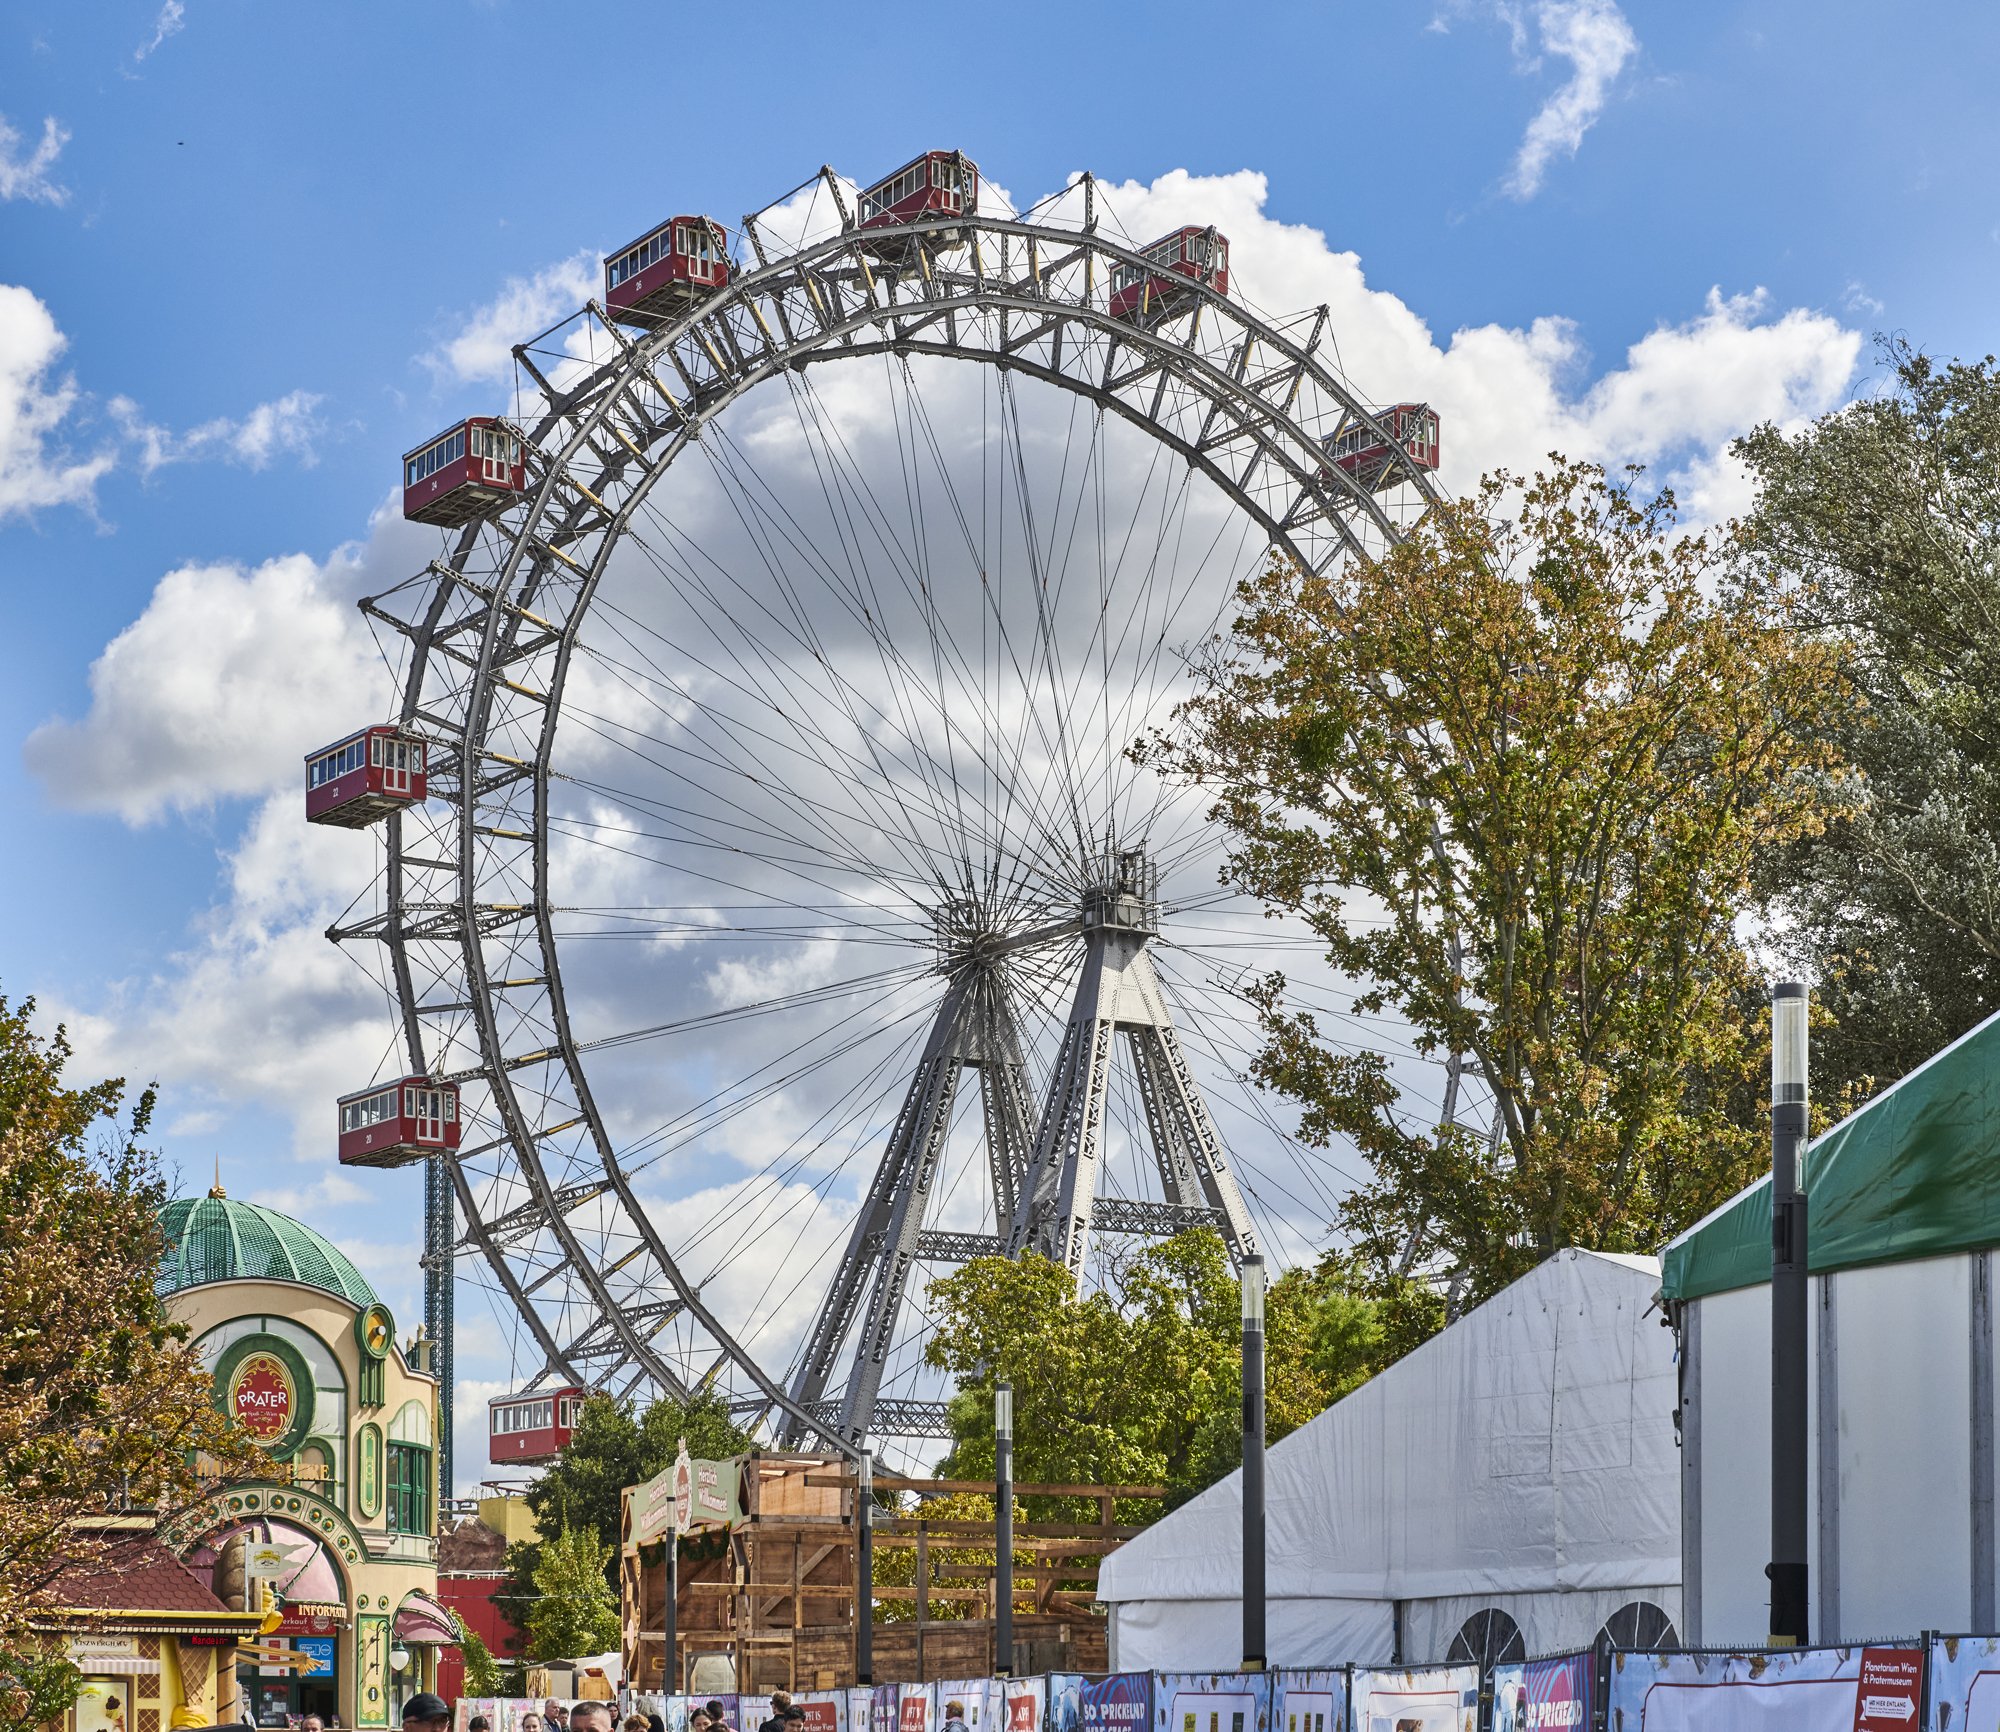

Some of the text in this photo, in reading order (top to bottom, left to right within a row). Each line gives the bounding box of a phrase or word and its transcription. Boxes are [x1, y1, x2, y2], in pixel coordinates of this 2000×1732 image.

[332, 787, 339, 798] 22
[366, 1134, 373, 1144] 20
[238, 1390, 287, 1407] PRATER
[519, 1440, 525, 1449] 18
[282, 1617, 307, 1625] erkauf
[1864, 1661, 1917, 1673] Planetarium Wien
[1863, 1674, 1912, 1686] & Pratermuseum
[1084, 1703, 1097, 1720] SO
[1526, 1703, 1537, 1728] SO
